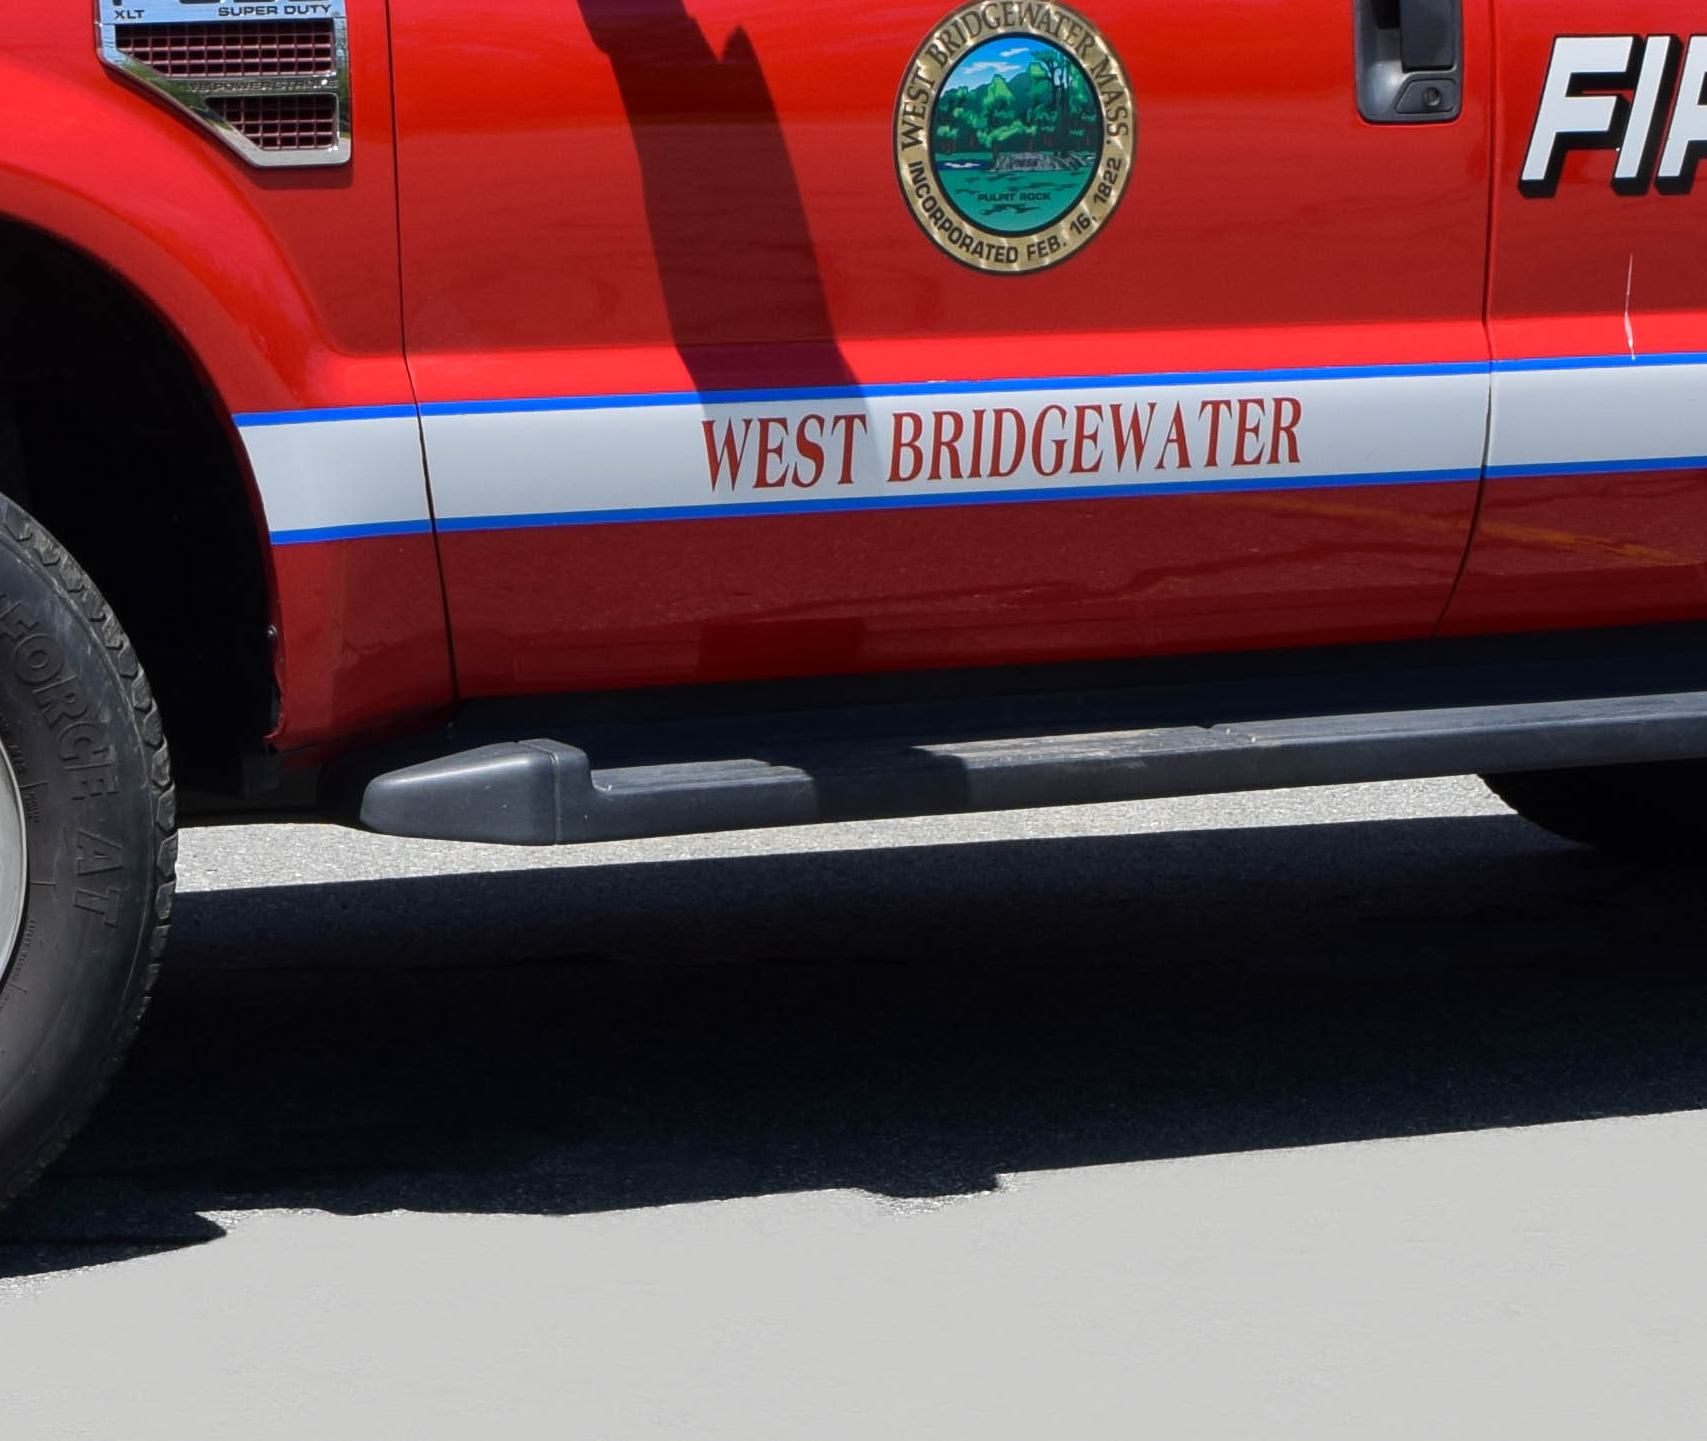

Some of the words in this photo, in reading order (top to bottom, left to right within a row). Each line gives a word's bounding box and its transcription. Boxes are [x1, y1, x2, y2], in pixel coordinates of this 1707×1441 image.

[113, 9, 146, 20] XLT
[218, 5, 279, 17] SUPER
[283, 3, 333, 15] DUTY
[900, 66, 935, 152] WEST
[924, 0, 1096, 67] BRIDGEWATER
[908, 159, 1020, 265] INCORPORATED
[1026, 234, 1067, 263] FEB.
[1093, 156, 1122, 206] 1822
[976, 192, 1015, 202] PULPIT
[1019, 191, 1051, 201] ROCK
[702, 413, 868, 493] WEST
[886, 396, 1303, 484] BRIDGEWATER
